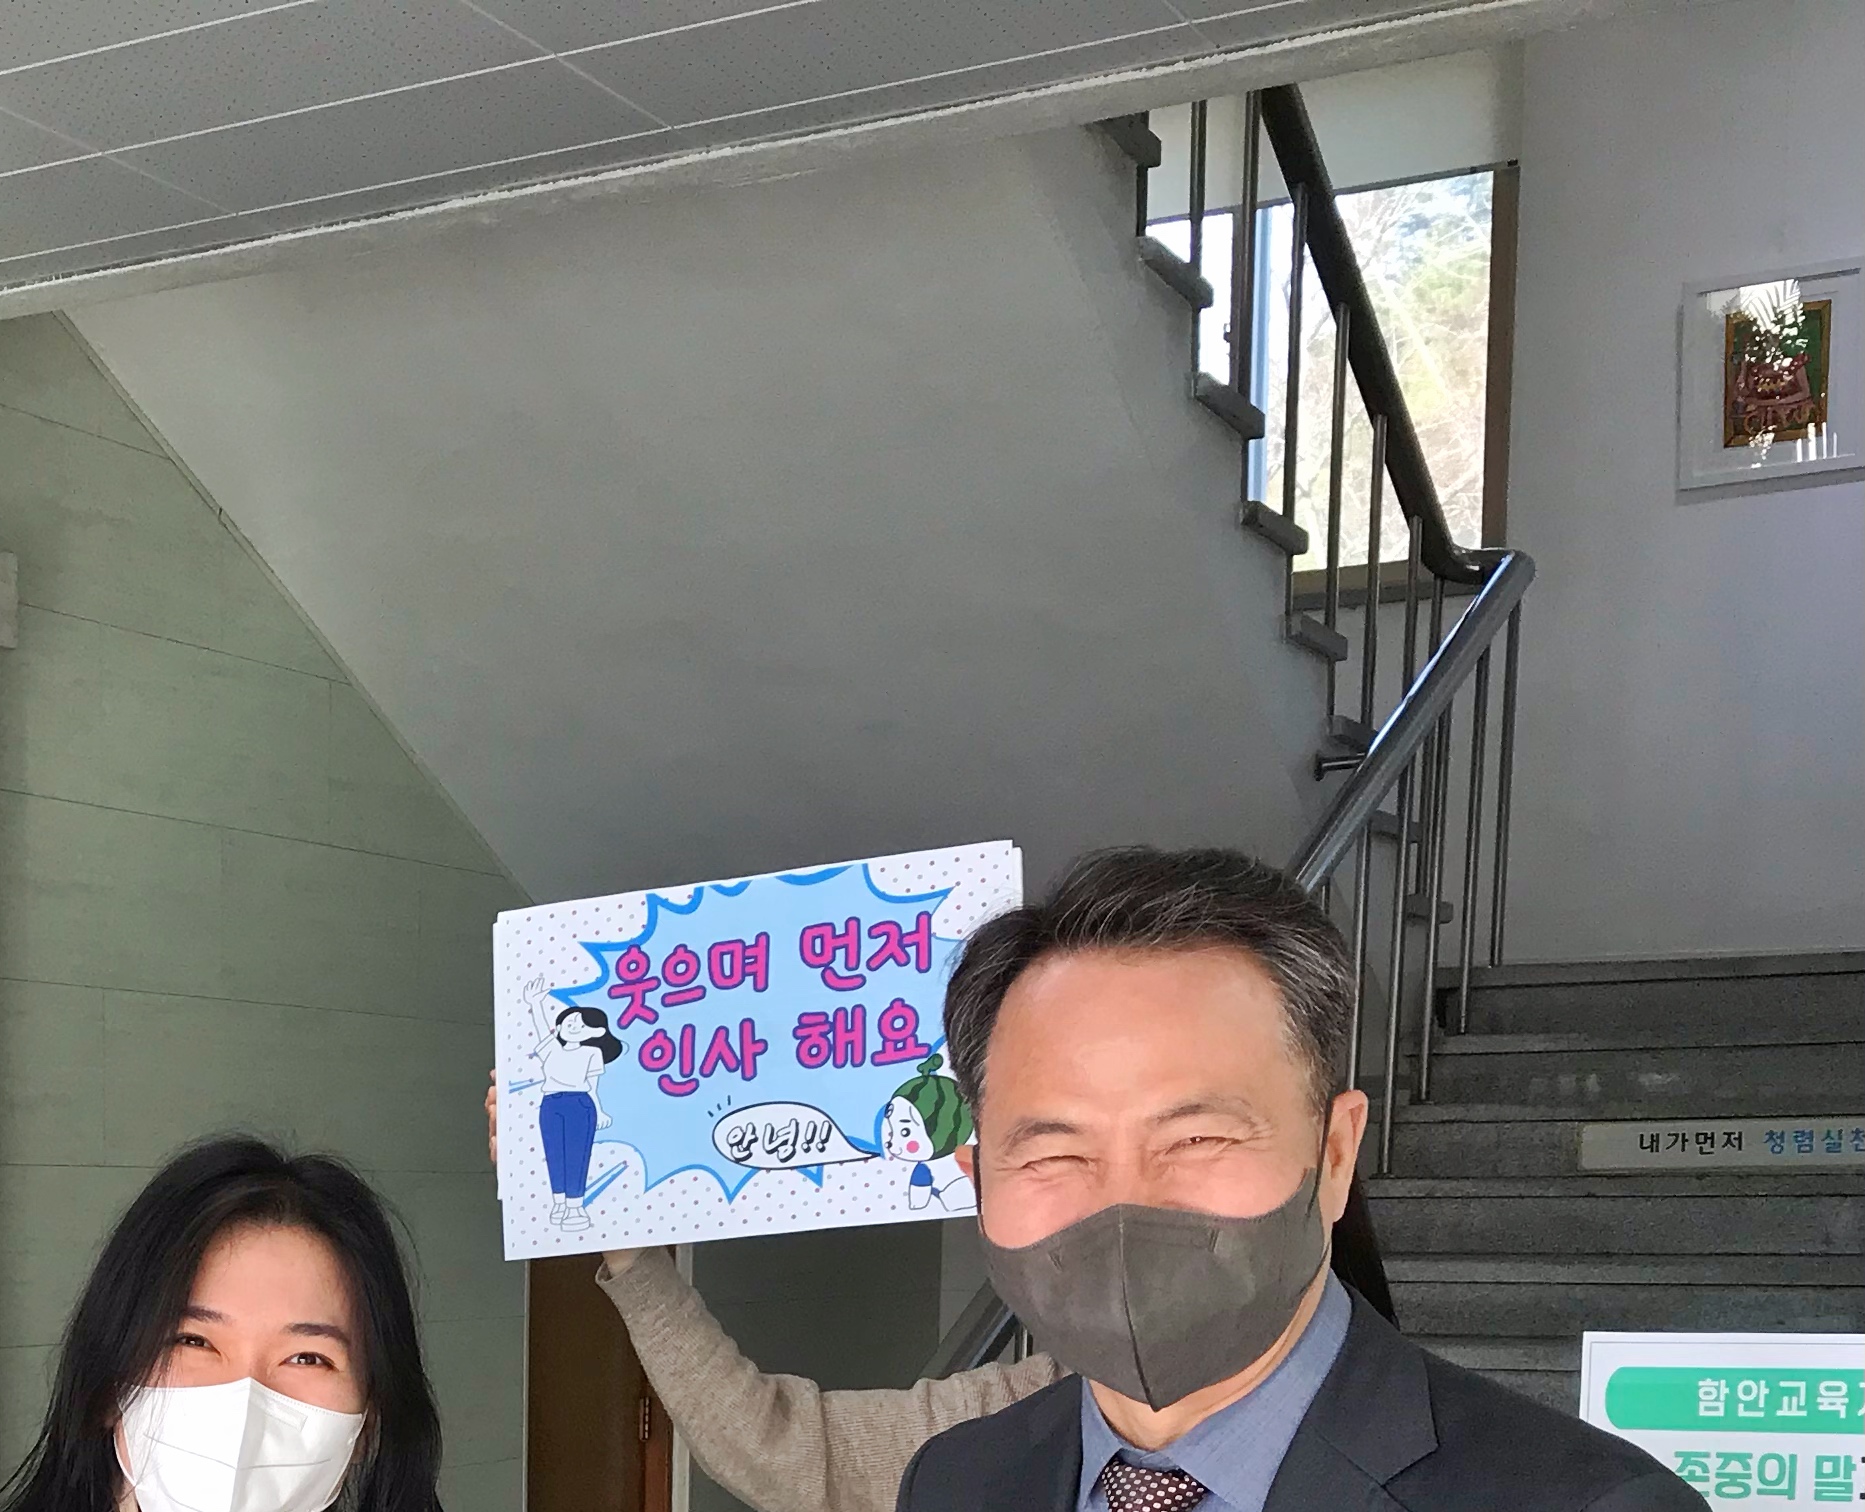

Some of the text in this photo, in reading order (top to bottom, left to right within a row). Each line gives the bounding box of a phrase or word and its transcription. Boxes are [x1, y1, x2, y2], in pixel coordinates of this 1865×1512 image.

[607, 910, 934, 1029] 웃으며 먼저
[638, 998, 932, 1097] 인사 해요
[1814, 1454, 1865, 1502] 말
